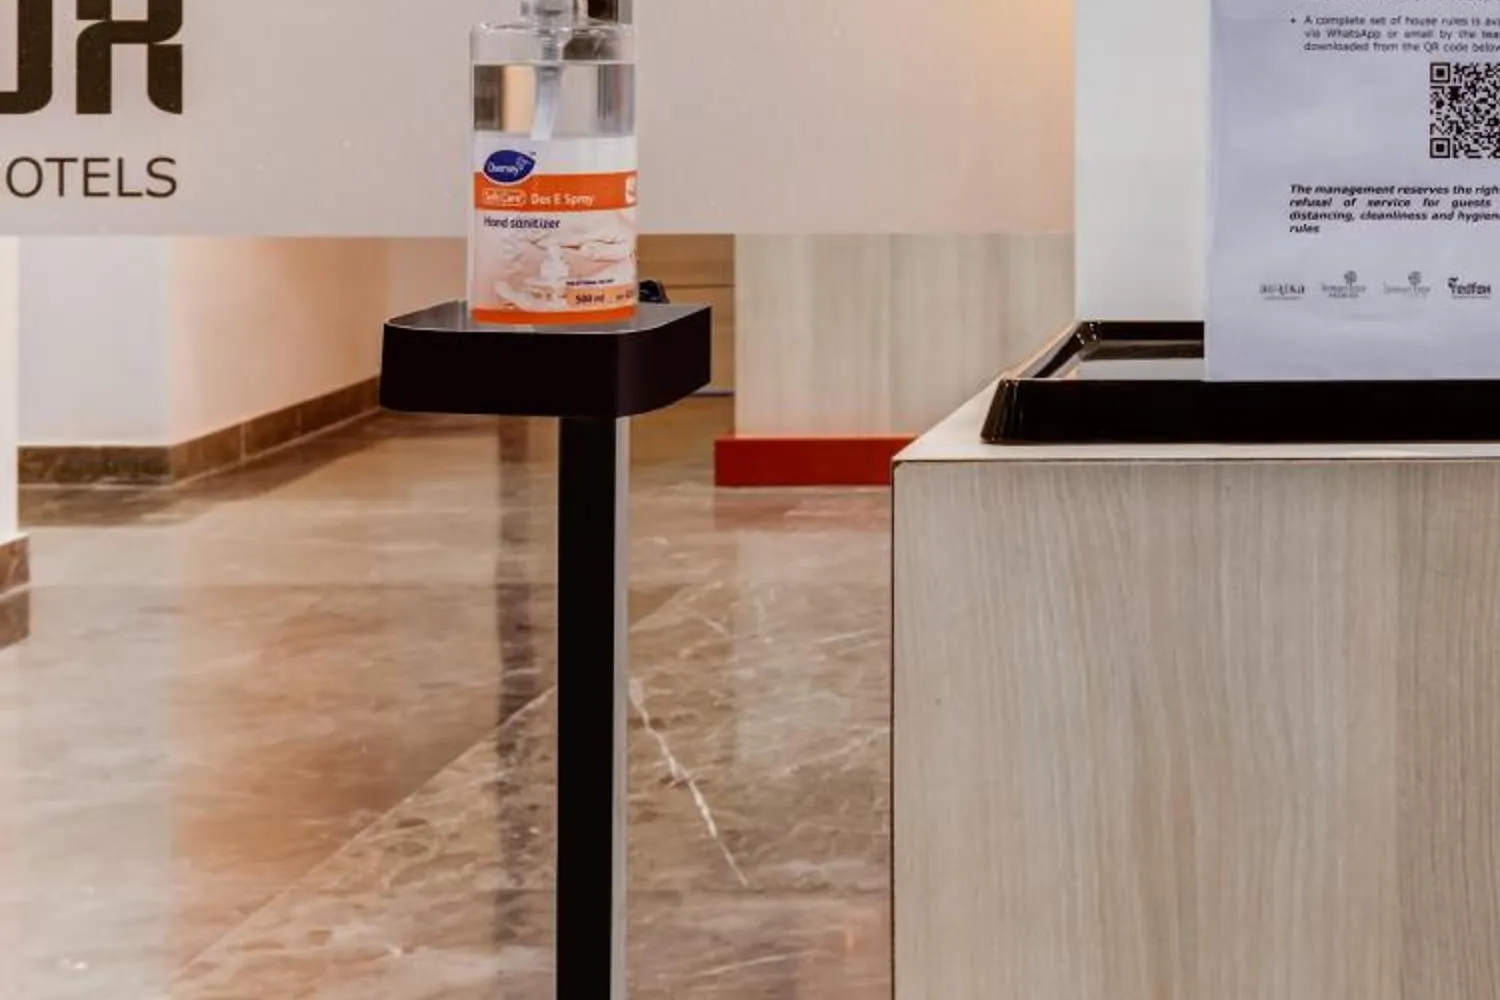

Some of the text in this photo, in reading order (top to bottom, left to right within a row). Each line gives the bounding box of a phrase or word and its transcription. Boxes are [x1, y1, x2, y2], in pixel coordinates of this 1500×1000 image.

[1304, 14, 1313, 26] A
[1388, 15, 1402, 26] of
[1403, 15, 1438, 26] house
[1438, 28, 1452, 42] by
[1457, 28, 1476, 39] the
[1371, 40, 1398, 52] from
[1400, 41, 1420, 52] the
[1422, 41, 1439, 52] QR
[1442, 41, 1468, 52] code
[6, 156, 178, 198] OTELS
[1289, 184, 1312, 195] The
[1313, 184, 1395, 197] management
[1395, 186, 1450, 195] reserves
[1451, 184, 1472, 195] the
[563, 193, 594, 208] Spray
[1288, 197, 1332, 208] refusal
[1342, 197, 1356, 208] of
[1366, 197, 1411, 208] service
[1421, 197, 1440, 208] for
[1450, 197, 1492, 210] guests
[482, 214, 561, 229] Hand sanitizer
[1358, 210, 1428, 221] cleanliness
[1430, 210, 1454, 221] and
[1288, 222, 1320, 233] rules
